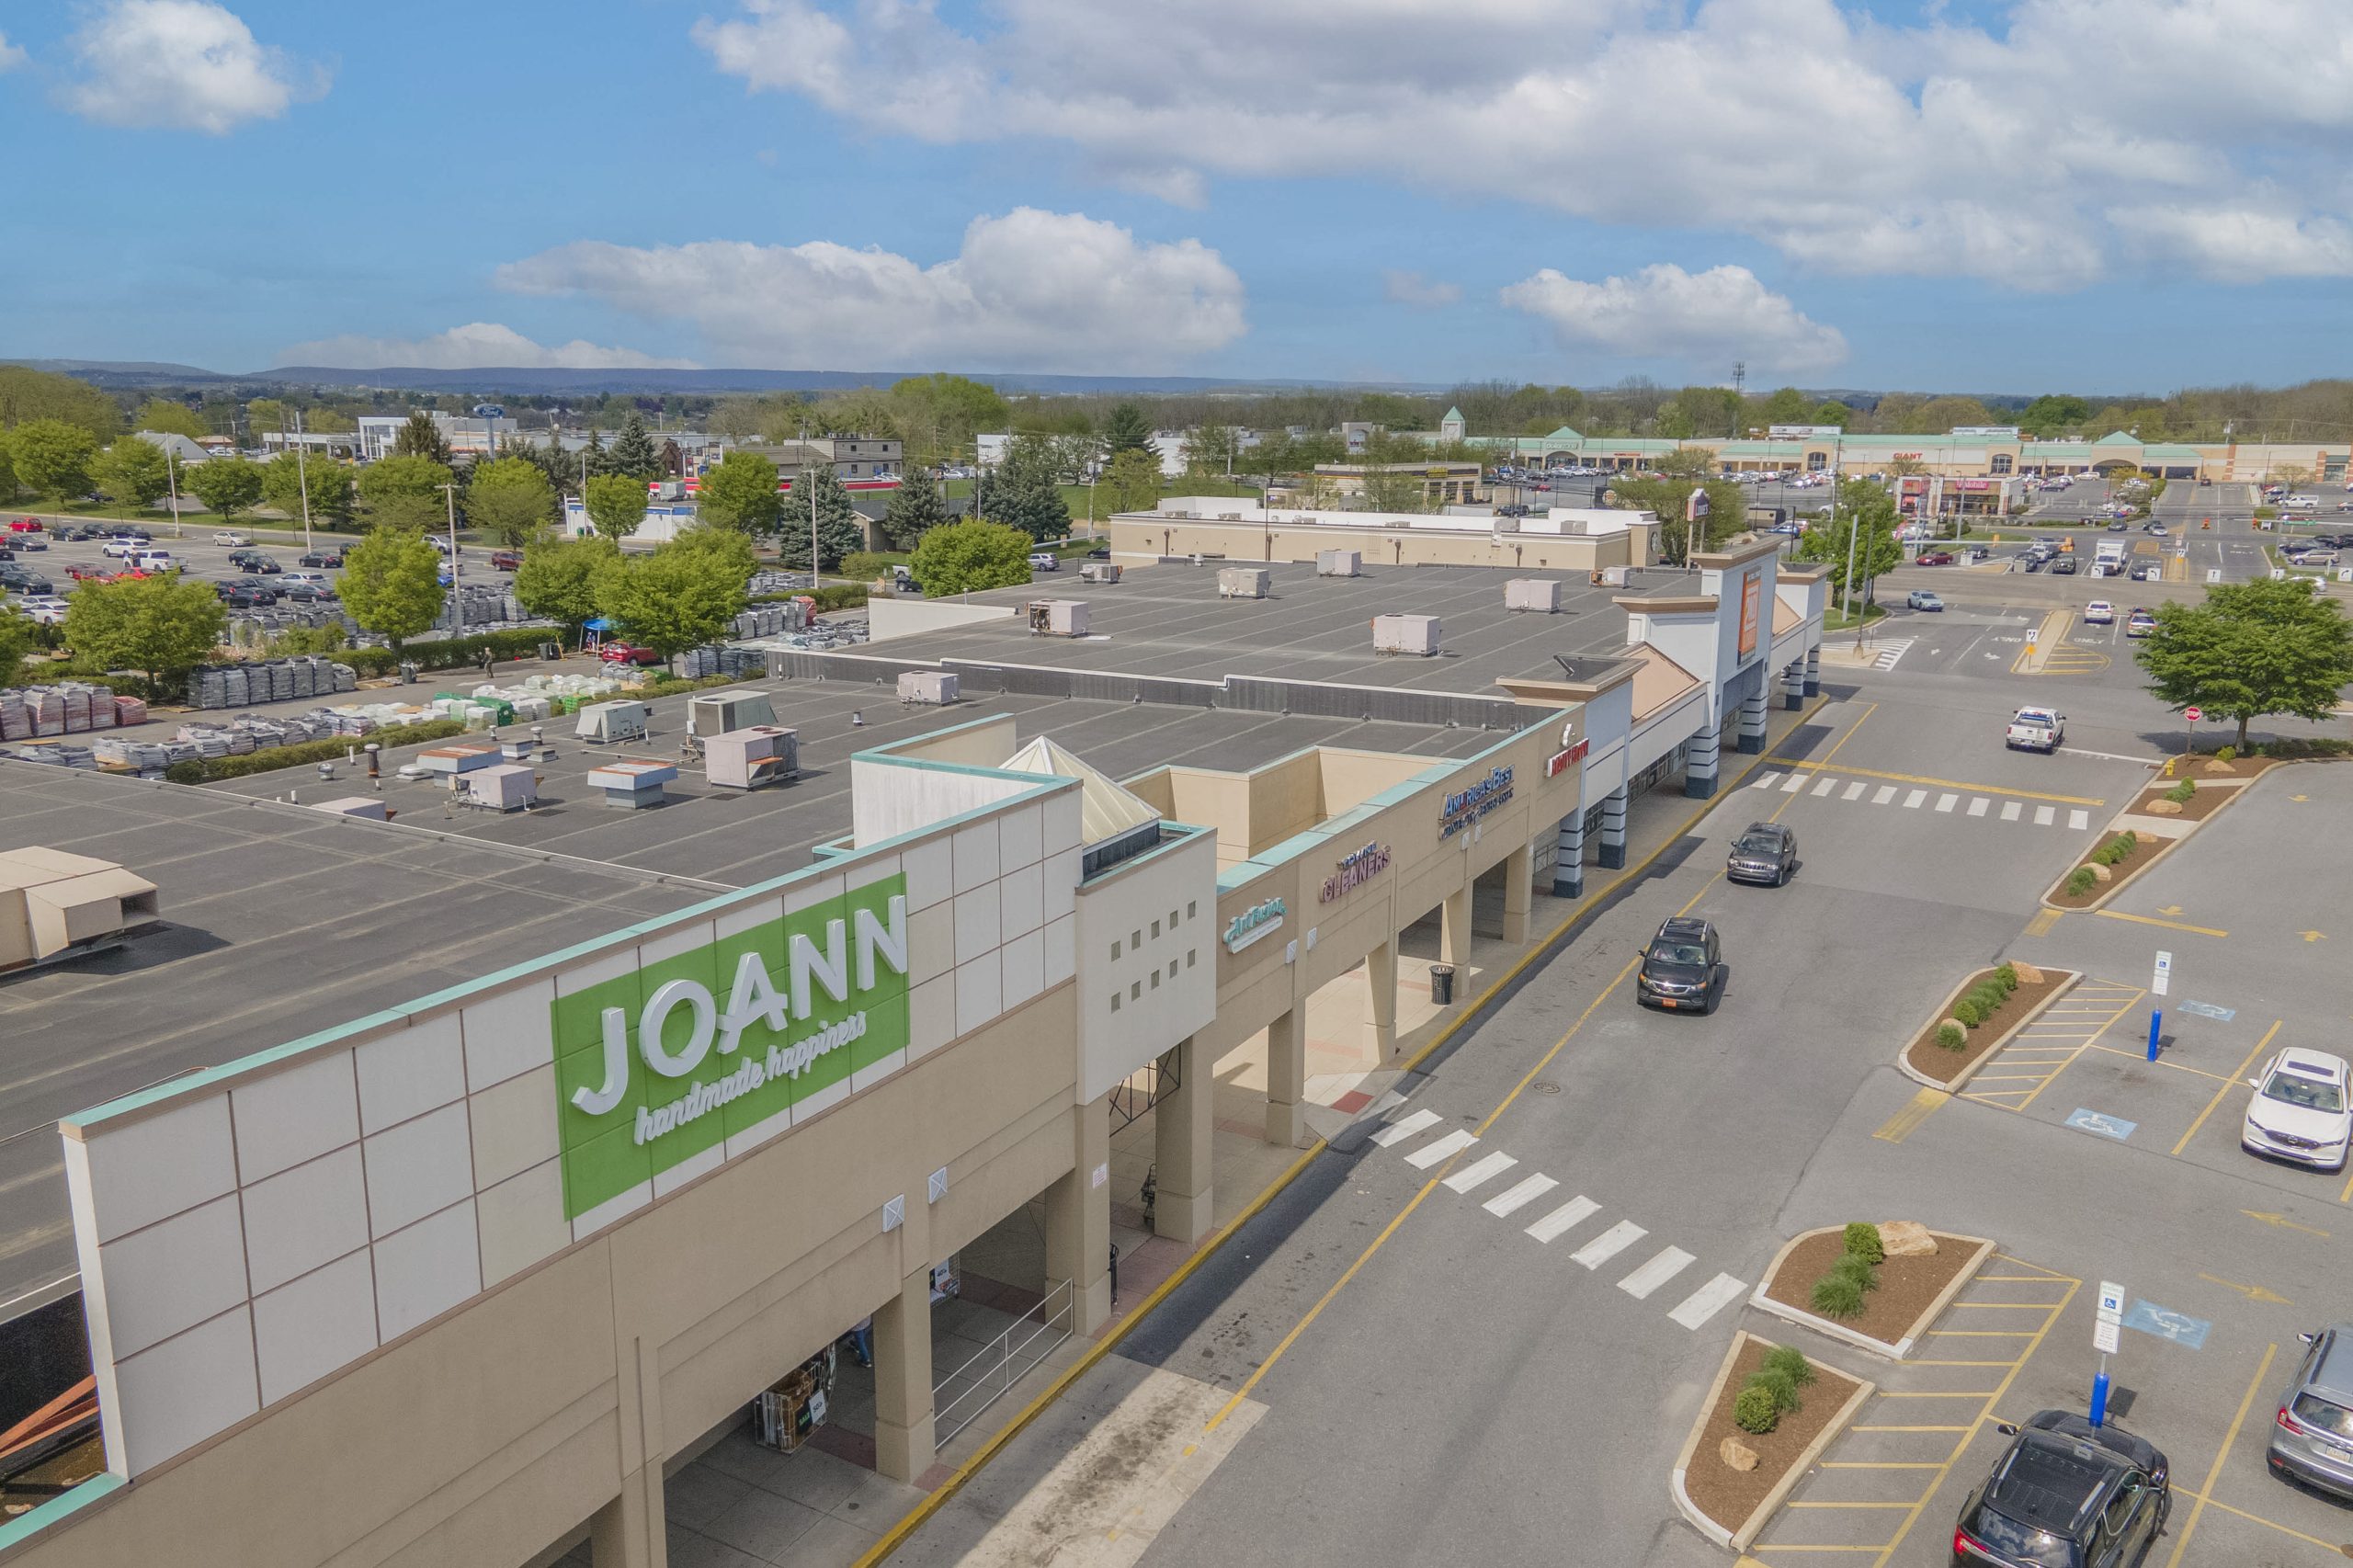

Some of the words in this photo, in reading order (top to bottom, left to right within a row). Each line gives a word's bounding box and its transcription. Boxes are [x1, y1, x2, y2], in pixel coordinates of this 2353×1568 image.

[1491, 764, 1515, 790] BEST
[1323, 846, 1392, 903] CLEANERS
[571, 894, 908, 1116] JOANN
[633, 1056, 766, 1146] handmade
[766, 1010, 868, 1082] happiness
